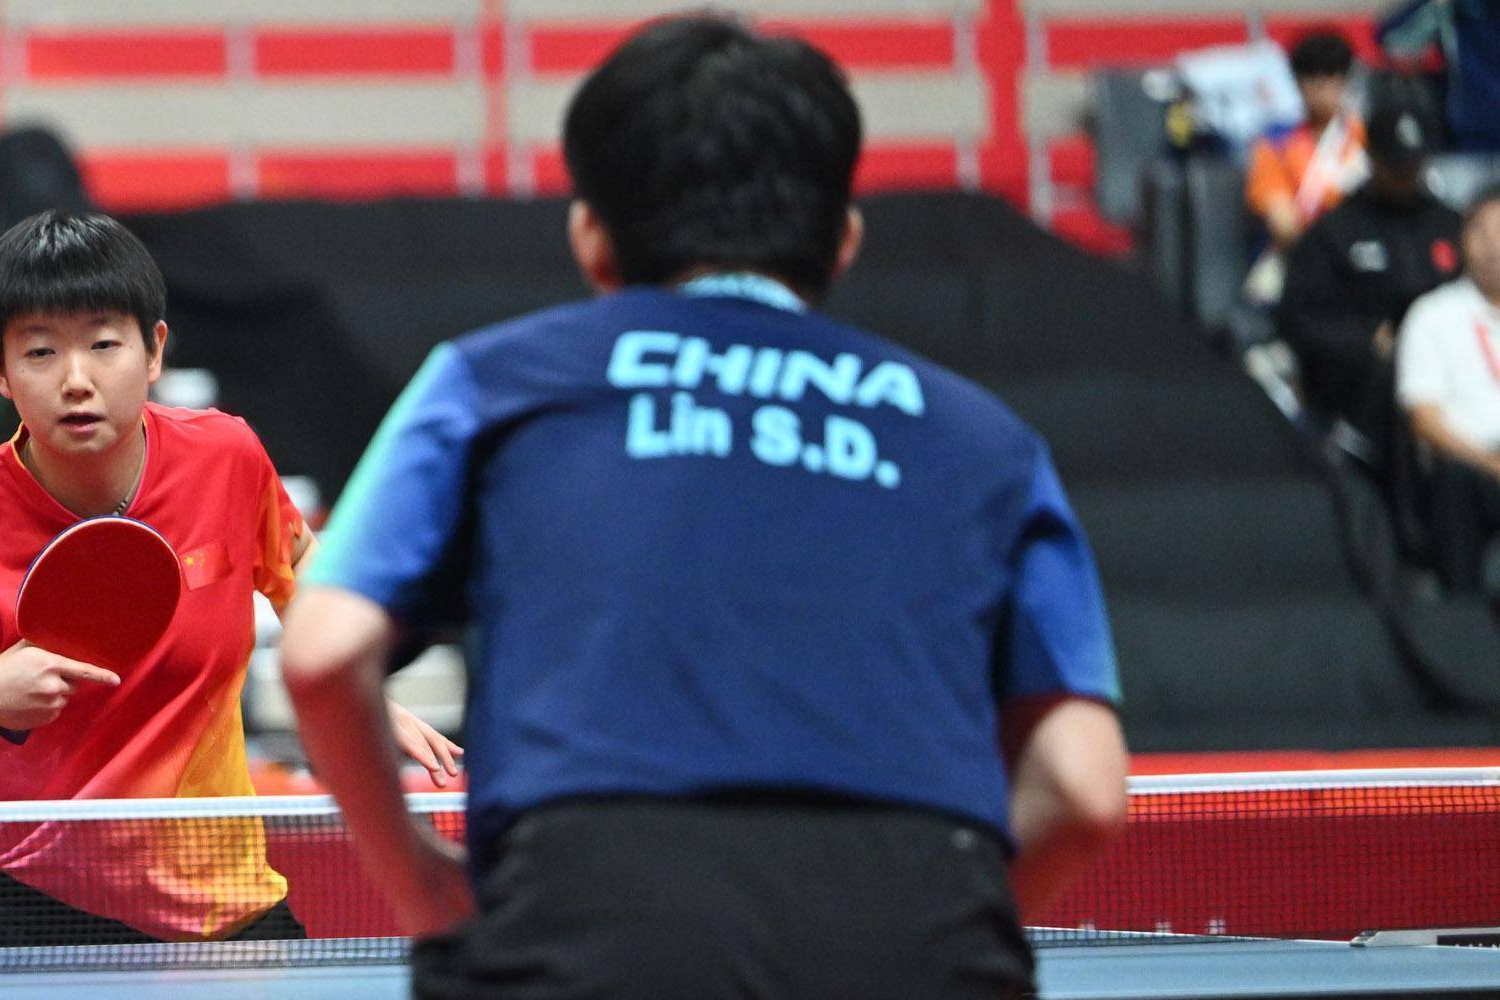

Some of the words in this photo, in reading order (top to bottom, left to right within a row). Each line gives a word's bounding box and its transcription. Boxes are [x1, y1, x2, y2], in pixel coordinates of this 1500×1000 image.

[606, 330, 925, 417] CHINA
[625, 391, 733, 460] Lin
[750, 404, 901, 489] S.D.
